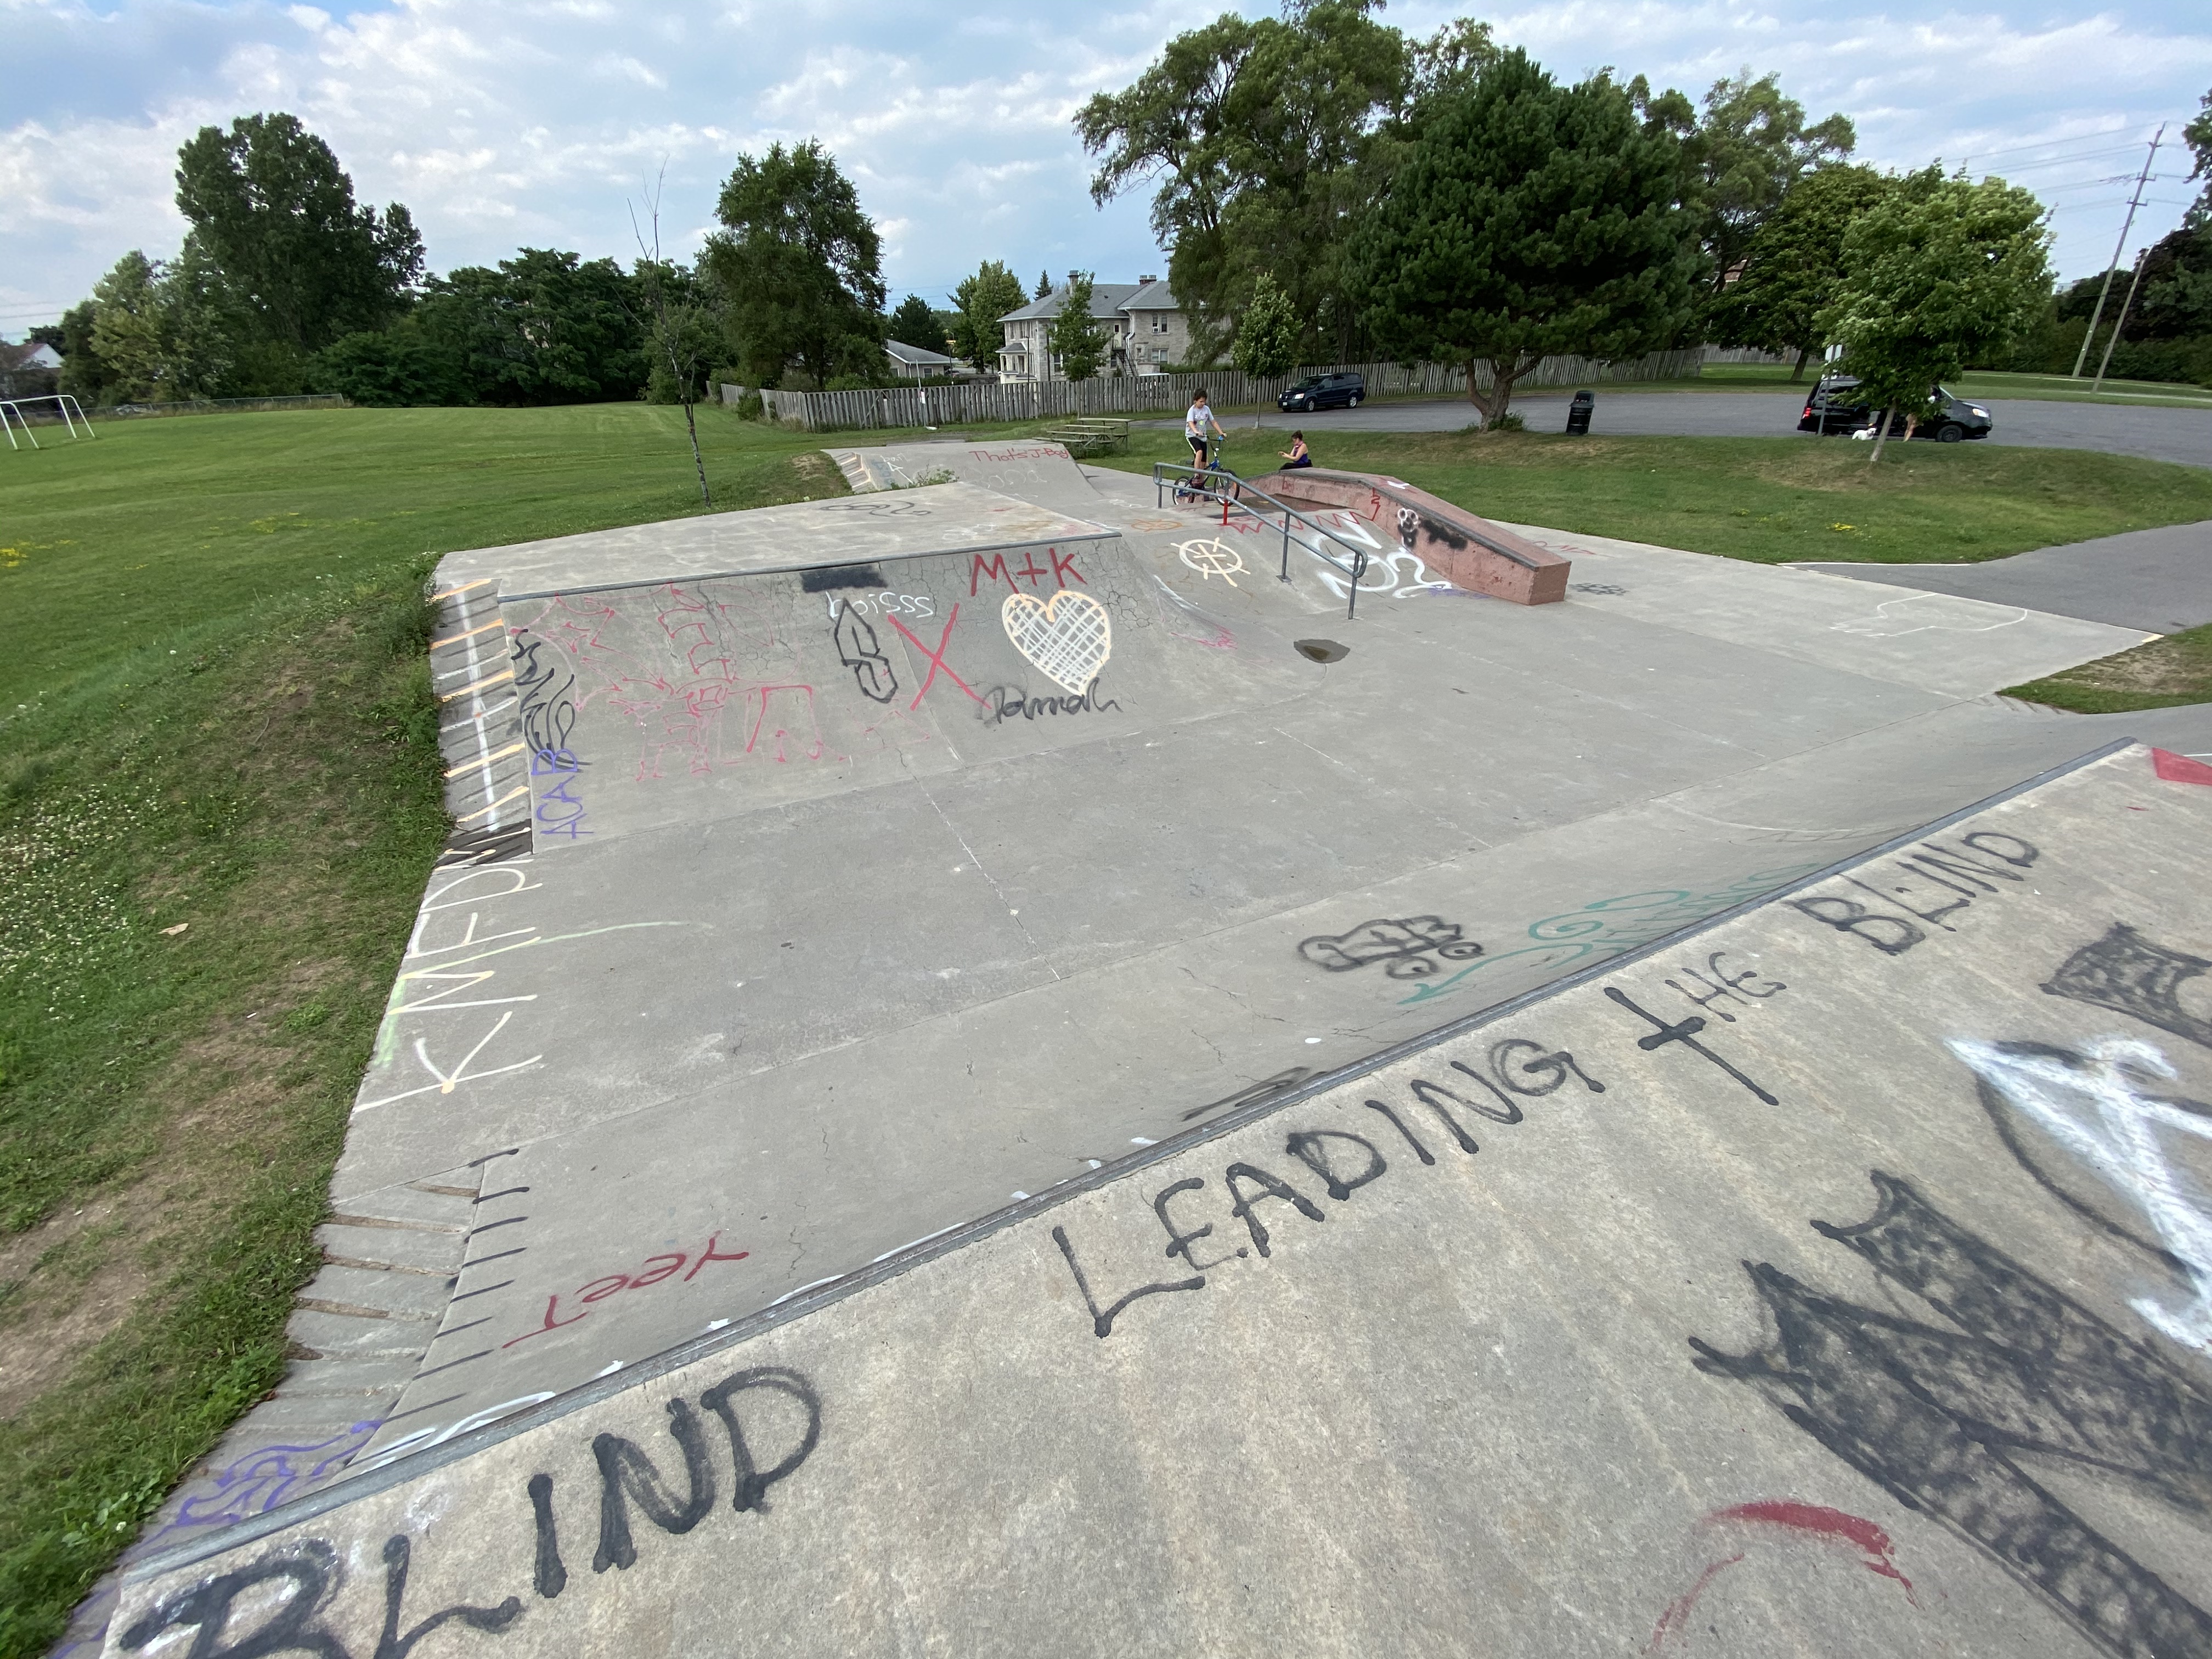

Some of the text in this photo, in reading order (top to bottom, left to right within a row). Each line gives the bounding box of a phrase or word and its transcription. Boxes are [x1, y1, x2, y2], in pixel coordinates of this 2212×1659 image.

[970, 548, 1088, 596] M+K
[531, 748, 595, 840] ACAB
[1052, 1038, 1606, 1339] LEADING
[1784, 832, 2040, 956] BLIND
